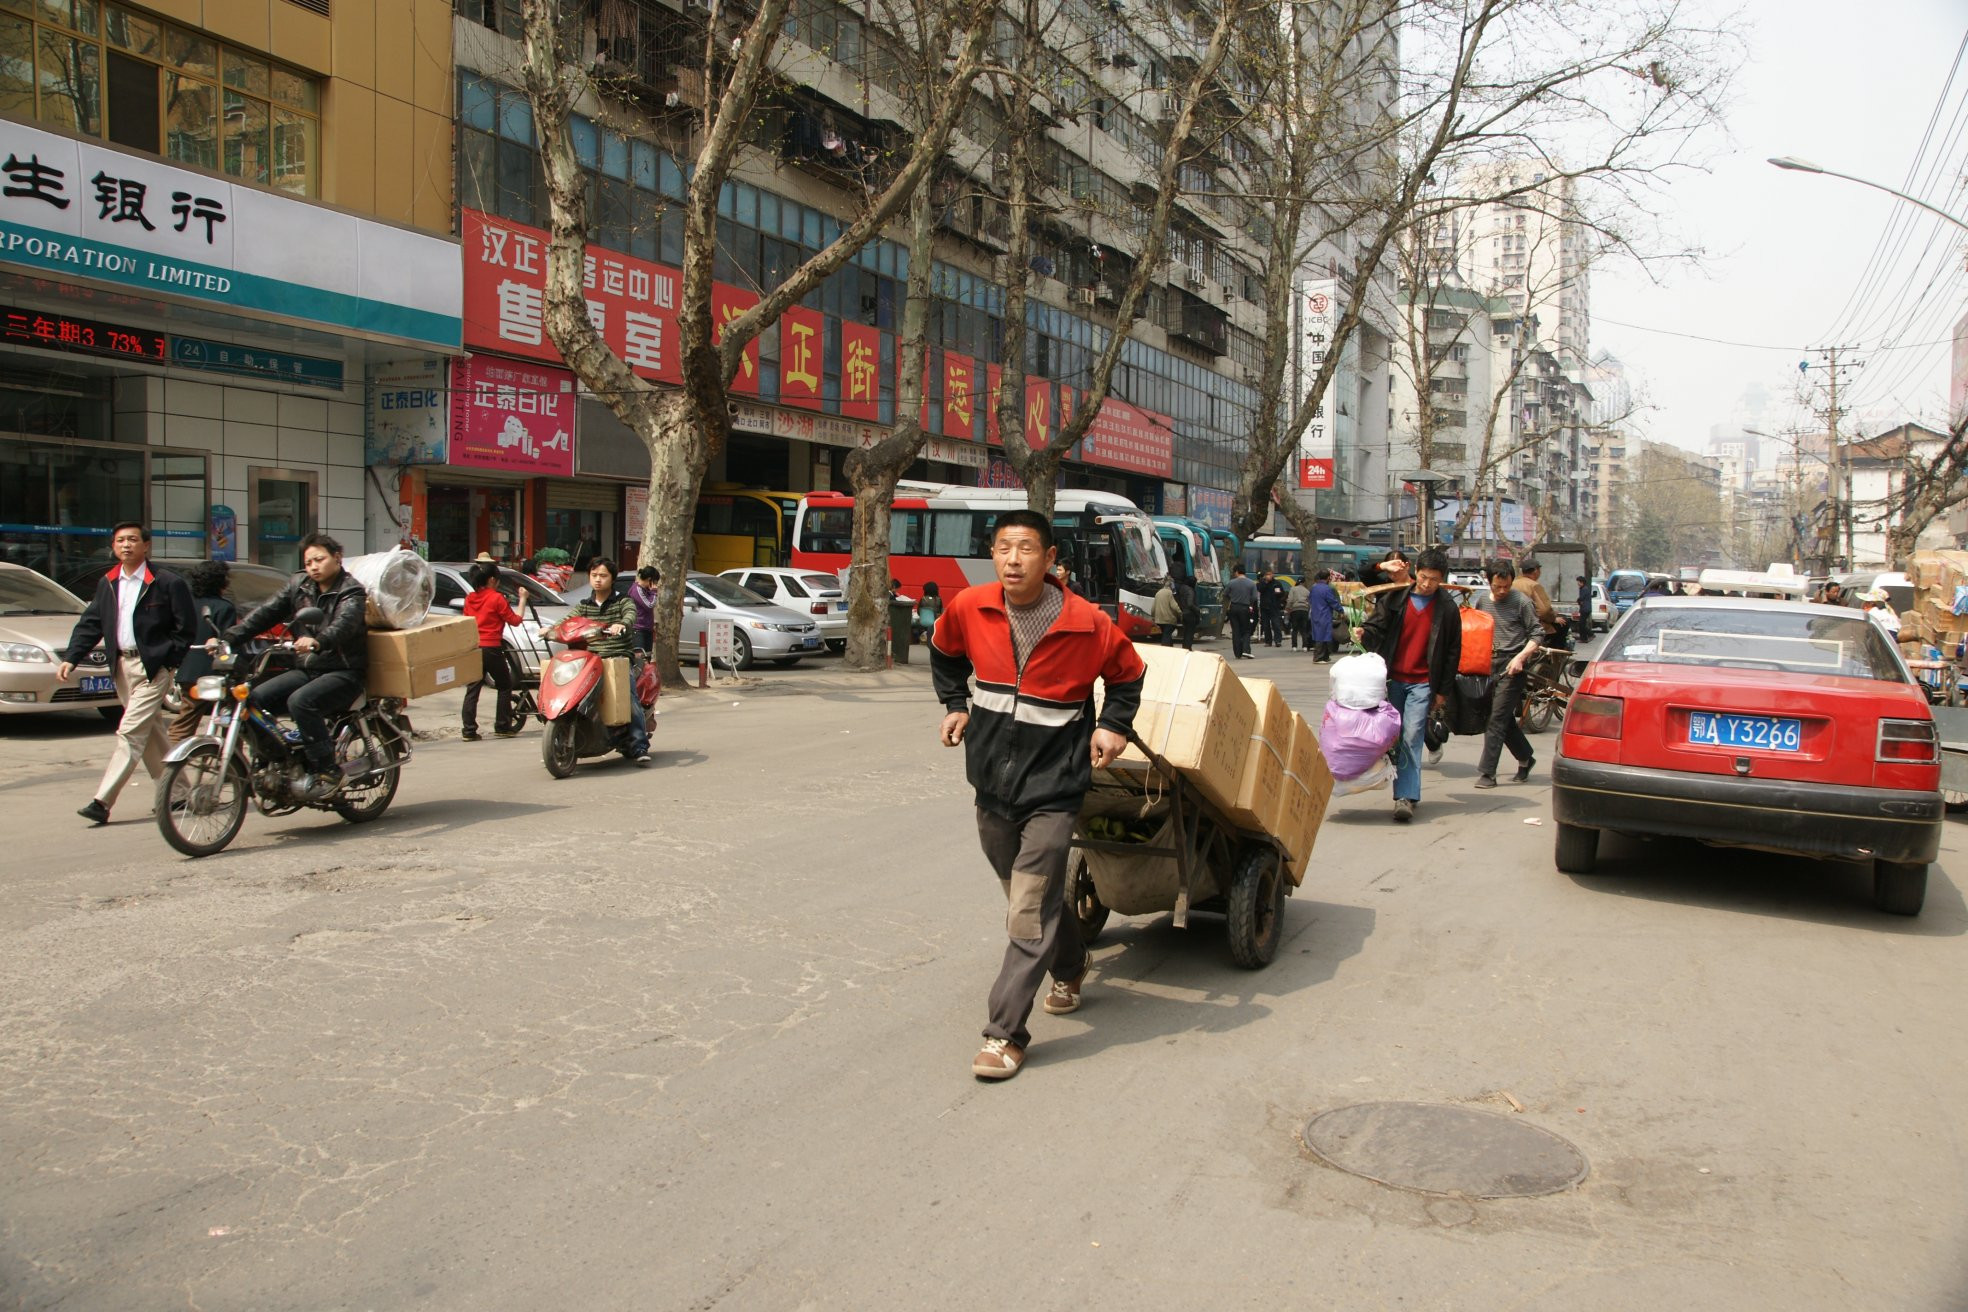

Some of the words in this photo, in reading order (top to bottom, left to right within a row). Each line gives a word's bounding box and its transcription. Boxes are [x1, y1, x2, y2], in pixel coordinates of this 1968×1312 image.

[1, 153, 226, 244] 生银行
[148, 263, 231, 294] LIMITED
[481, 225, 673, 309] 汉正客运中心
[184, 343, 200, 357] 24
[381, 388, 438, 410] 正泰日化
[474, 380, 558, 417] 正泰日化
[1311, 332, 1325, 438] 中国银行
[777, 411, 814, 440] 沙湖
[1307, 465, 1325, 475] 24h
[1728, 719, 1797, 746] Y3266
